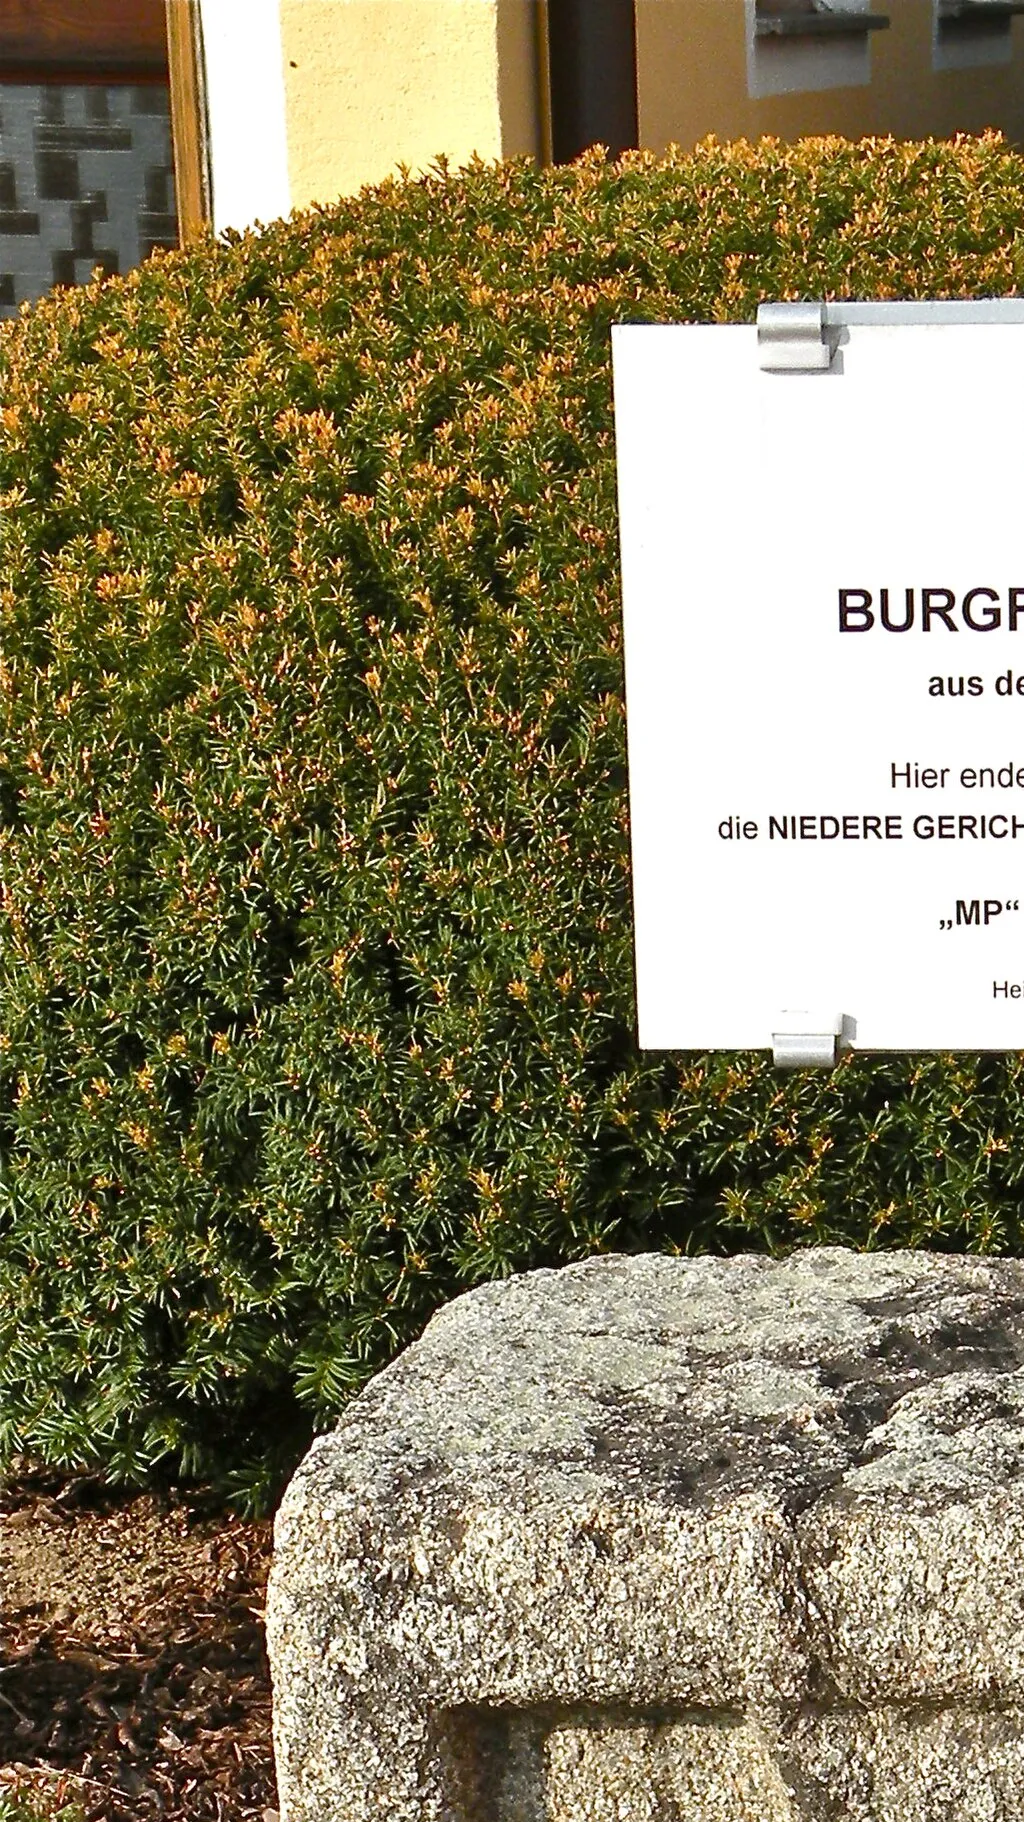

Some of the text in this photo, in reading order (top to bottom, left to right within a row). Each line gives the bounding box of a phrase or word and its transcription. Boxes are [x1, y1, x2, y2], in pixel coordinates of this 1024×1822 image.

[929, 675, 983, 697] aus
[891, 762, 951, 789] Hier
[718, 815, 759, 840] die
[768, 815, 903, 840] NIEDERE
